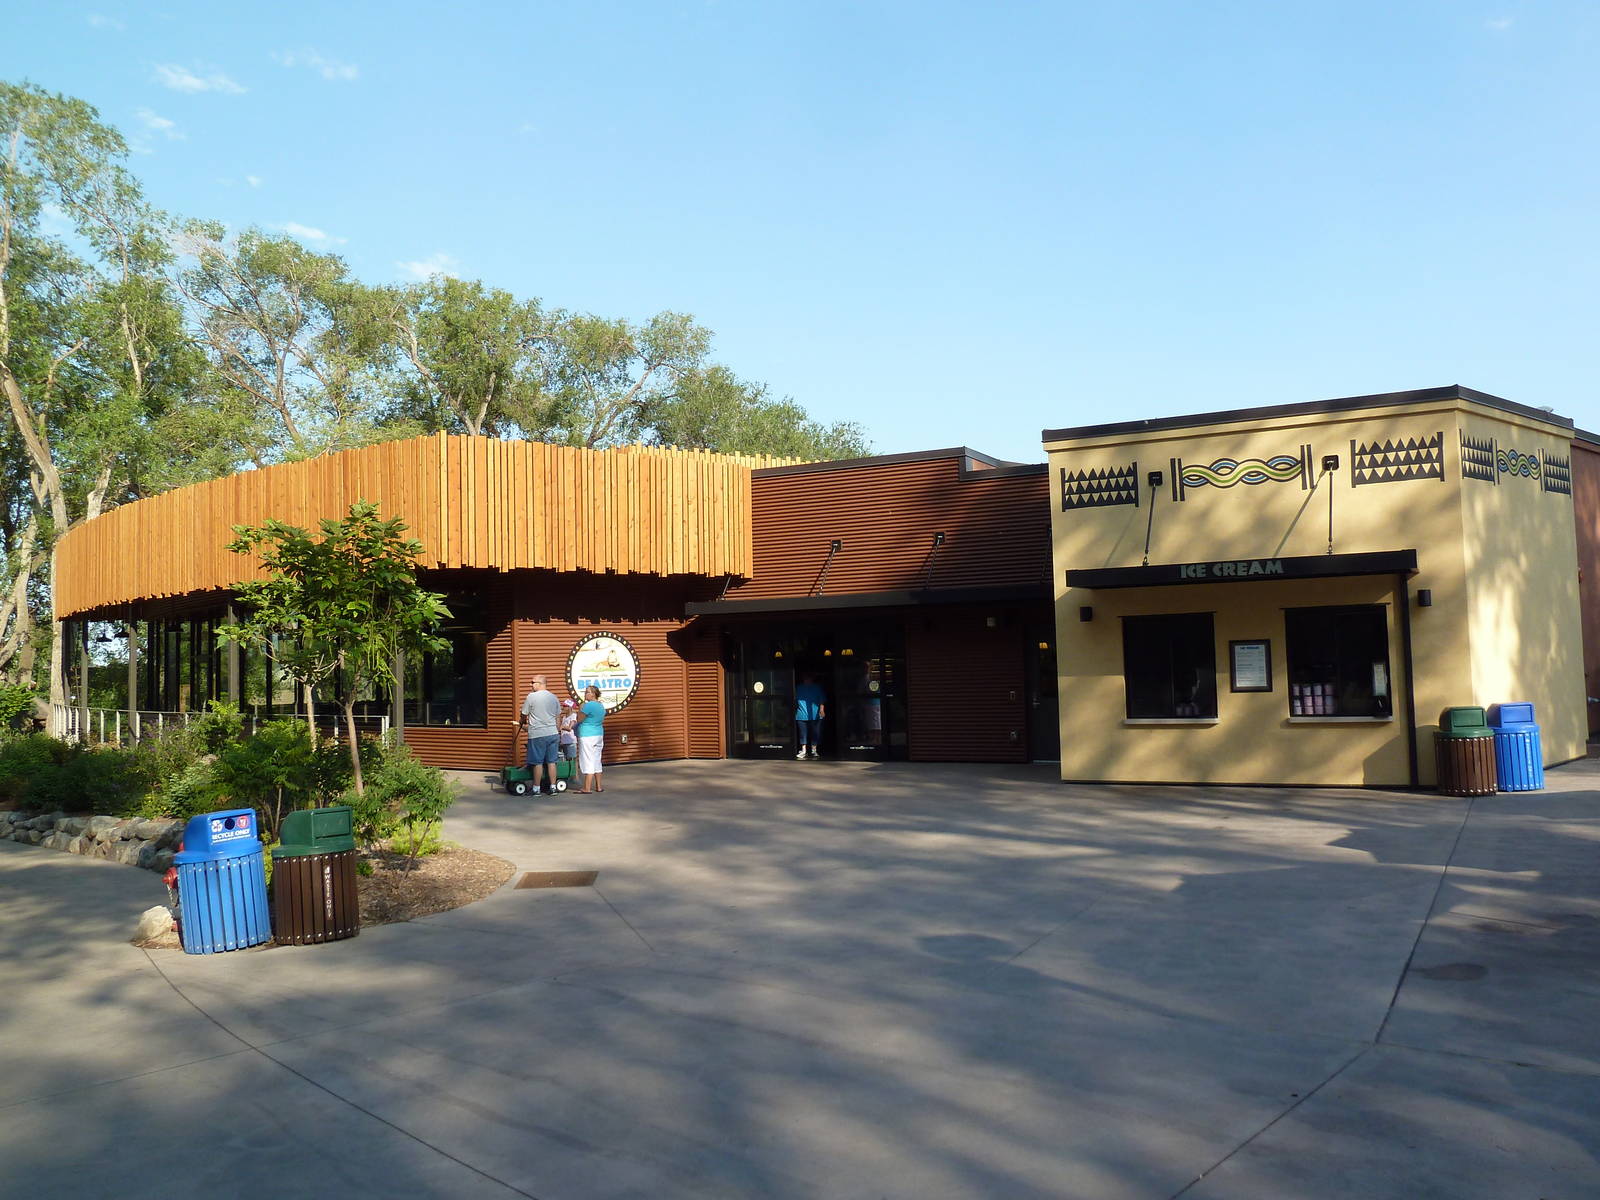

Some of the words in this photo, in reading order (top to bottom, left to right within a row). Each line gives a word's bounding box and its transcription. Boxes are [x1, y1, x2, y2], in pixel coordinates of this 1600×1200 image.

[1180, 564, 1207, 579] ICE
[1212, 560, 1284, 577] CREAM
[577, 678, 632, 689] BEASTRO
[211, 831, 234, 840] RECYCLE
